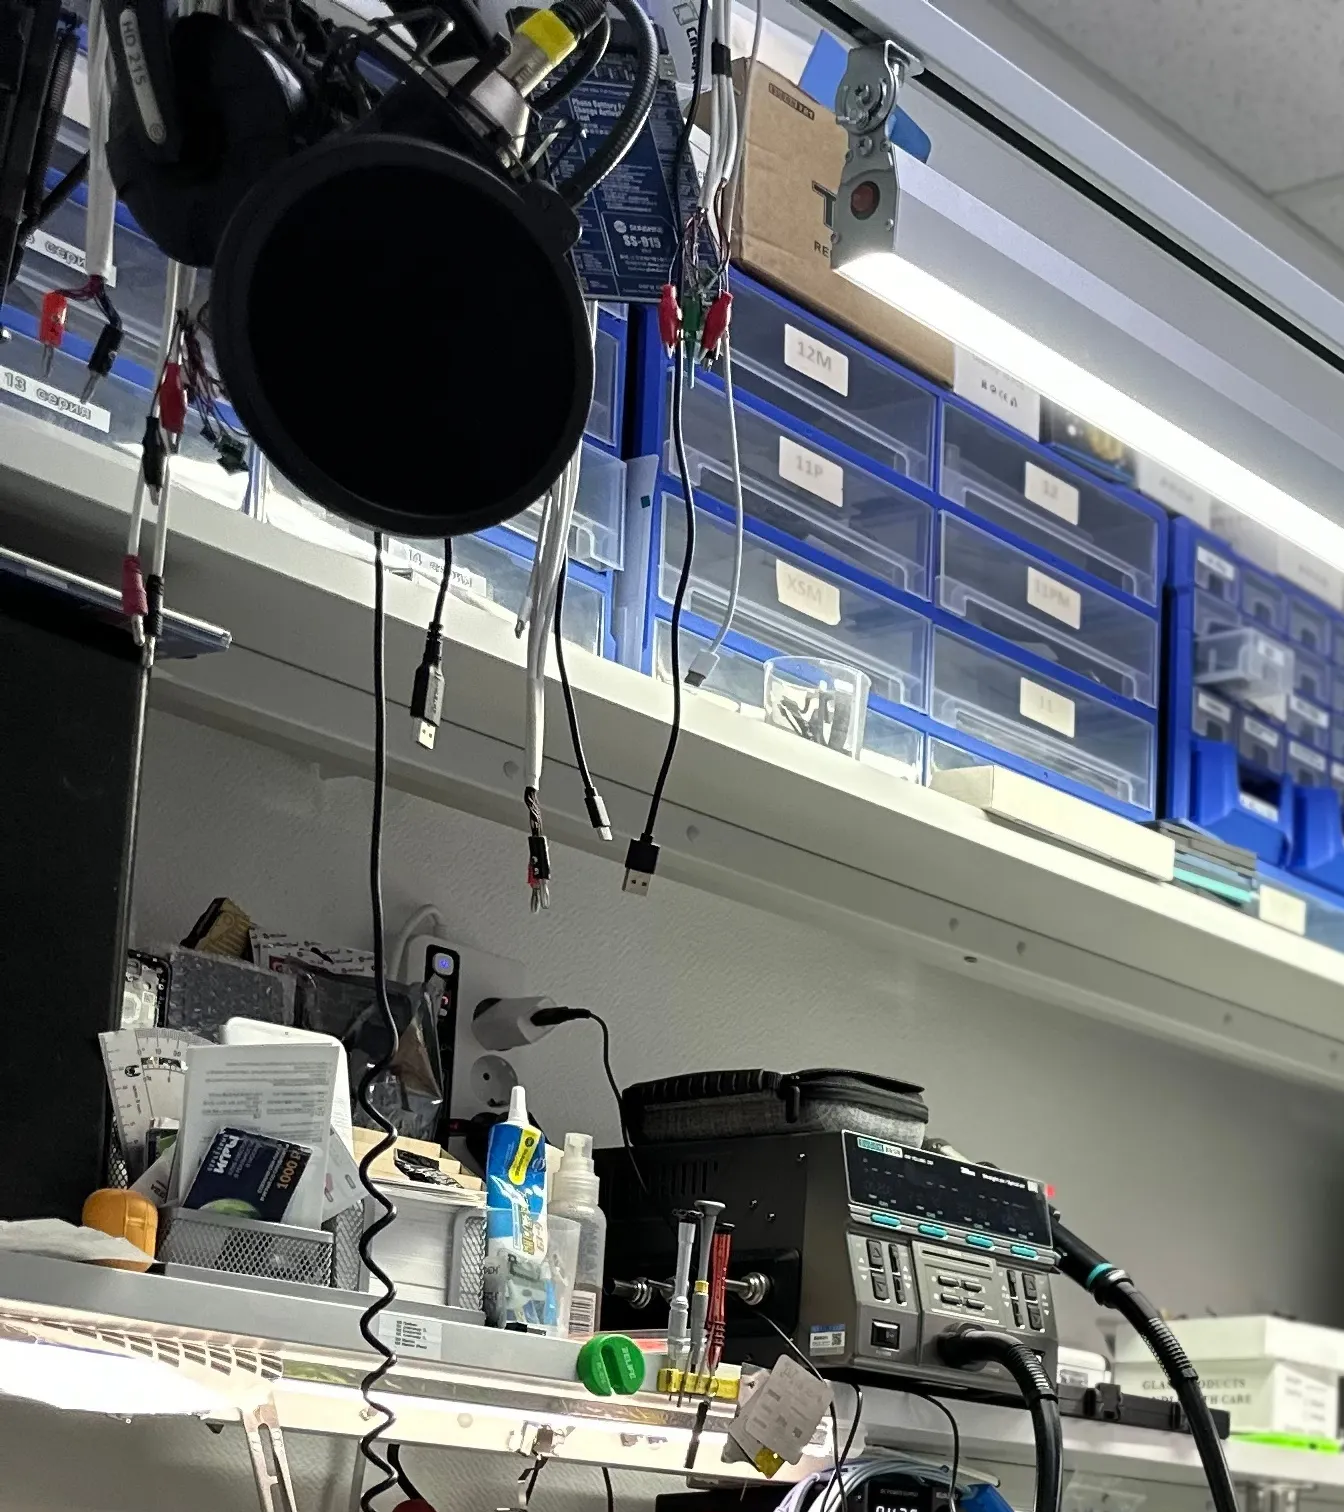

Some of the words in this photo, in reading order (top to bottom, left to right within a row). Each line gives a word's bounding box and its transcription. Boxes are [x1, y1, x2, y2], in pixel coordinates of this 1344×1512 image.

[122, 21, 135, 46] HD
[129, 53, 148, 85] 215
[45, 240, 86, 268] сери
[814, 240, 830, 258] RE
[797, 341, 832, 372] 12M
[4, 371, 27, 393] 13
[36, 386, 92, 420] серия
[796, 455, 824, 479] 11P
[786, 573, 823, 606] XSM
[277, 1161, 298, 1190] 1000
